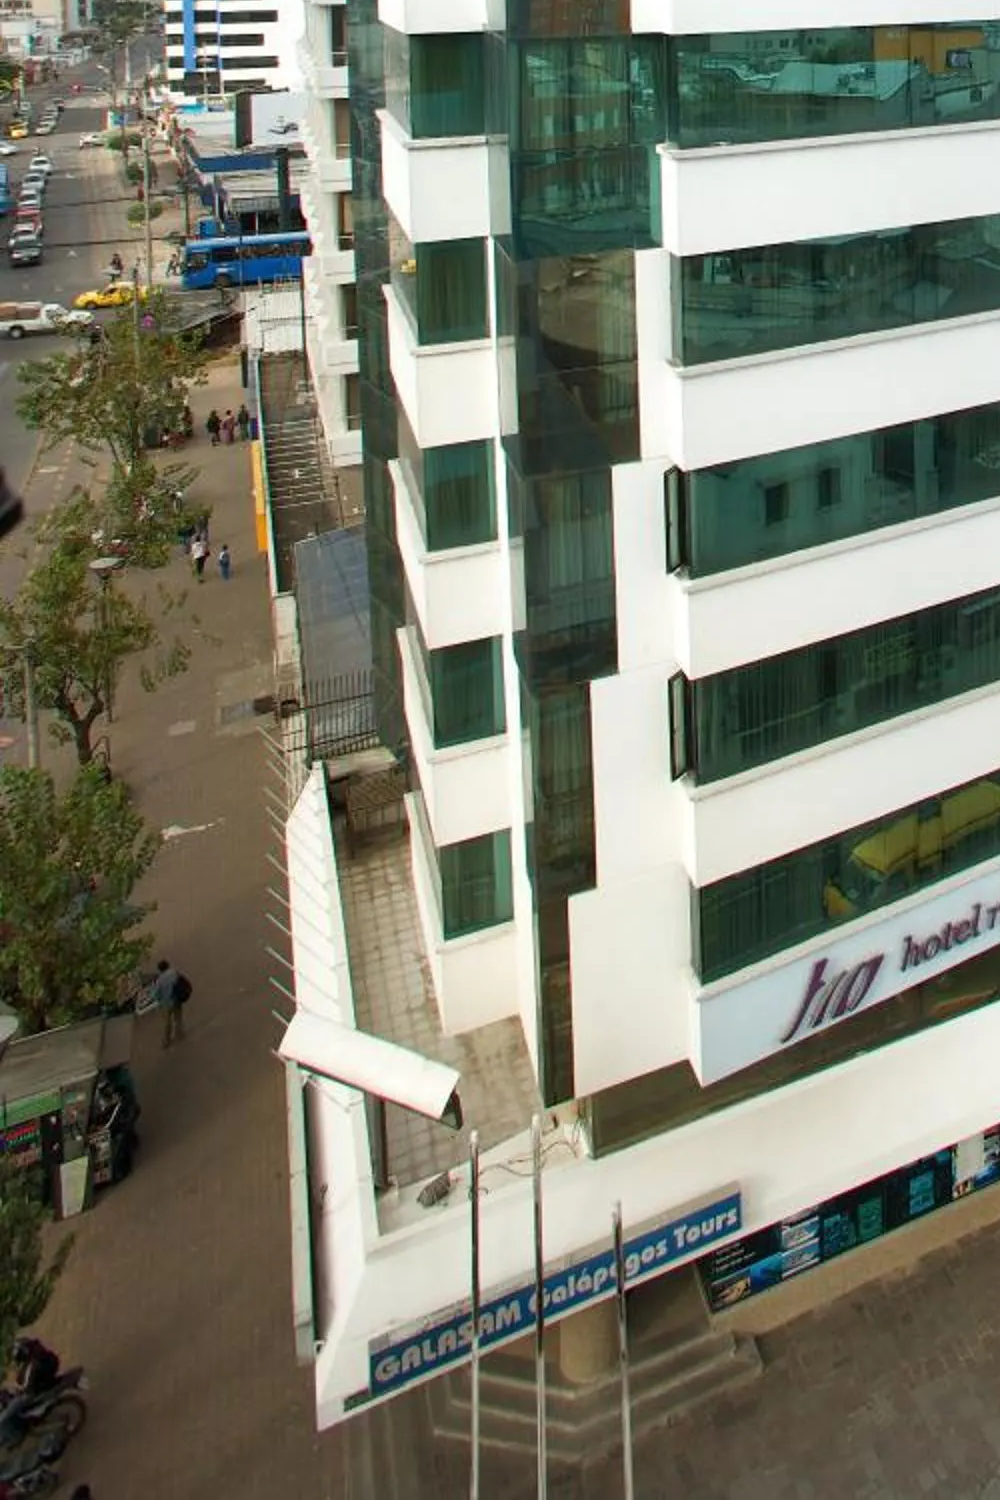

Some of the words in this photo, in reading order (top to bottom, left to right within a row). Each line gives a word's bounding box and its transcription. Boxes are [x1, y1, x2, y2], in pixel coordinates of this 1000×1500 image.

[900, 904, 980, 971] hotel
[375, 1299, 521, 1382] GALASAM
[673, 1205, 738, 1248] Tours
